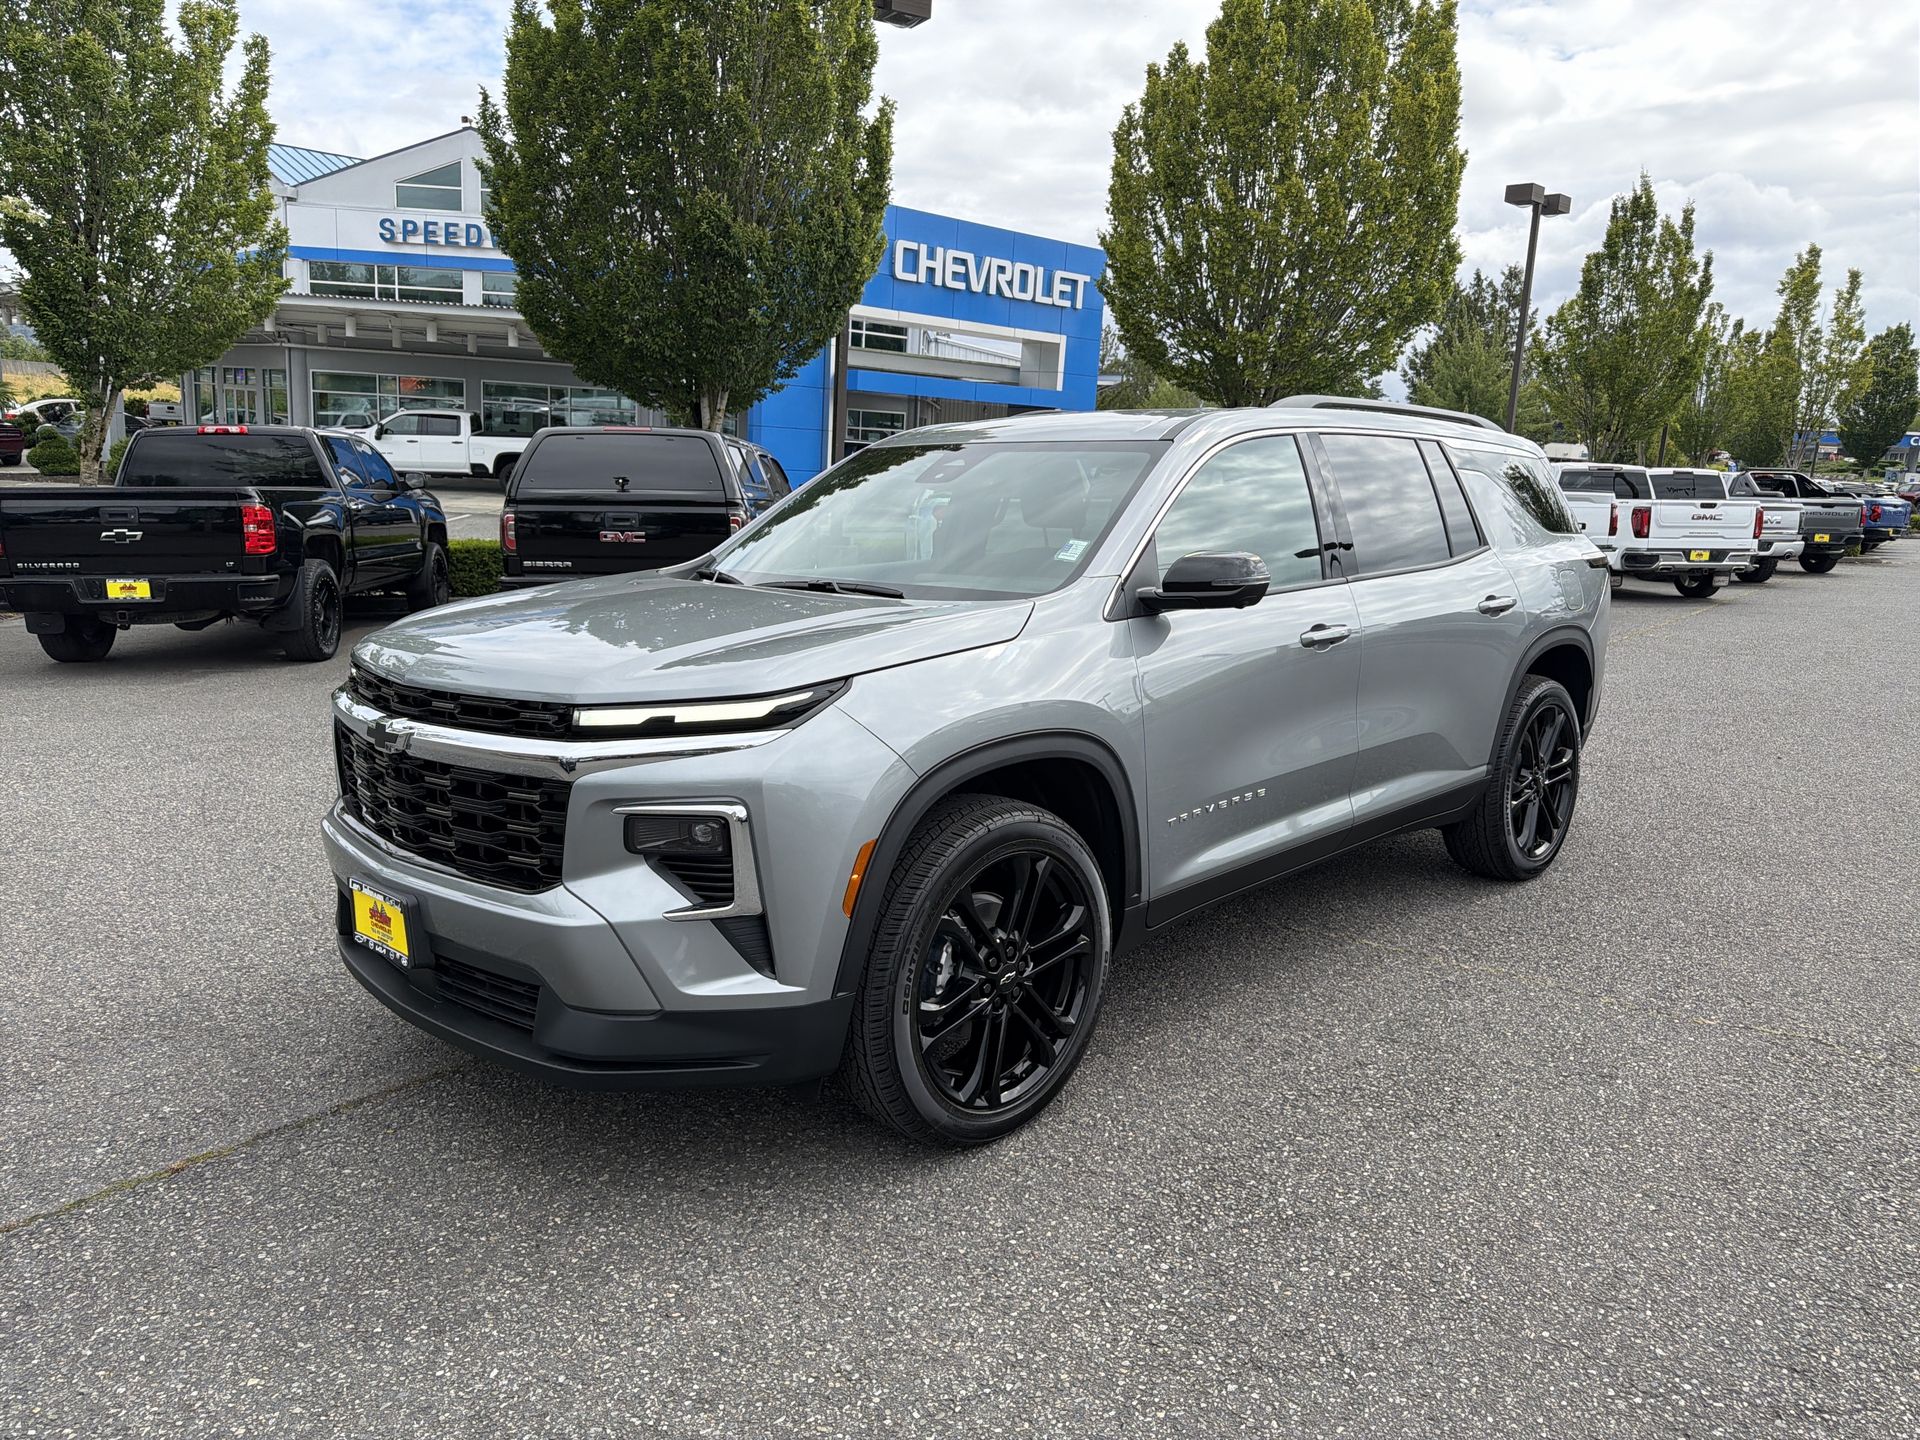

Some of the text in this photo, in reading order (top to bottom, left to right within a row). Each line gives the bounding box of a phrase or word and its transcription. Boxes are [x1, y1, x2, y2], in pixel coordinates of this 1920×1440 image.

[894, 239, 1091, 310] CHEVROLET
[1691, 513, 1723, 521] GMC
[600, 530, 646, 543] GMC
[522, 560, 572, 568] SIERRA
[1167, 788, 1266, 828] TRAVERSE
